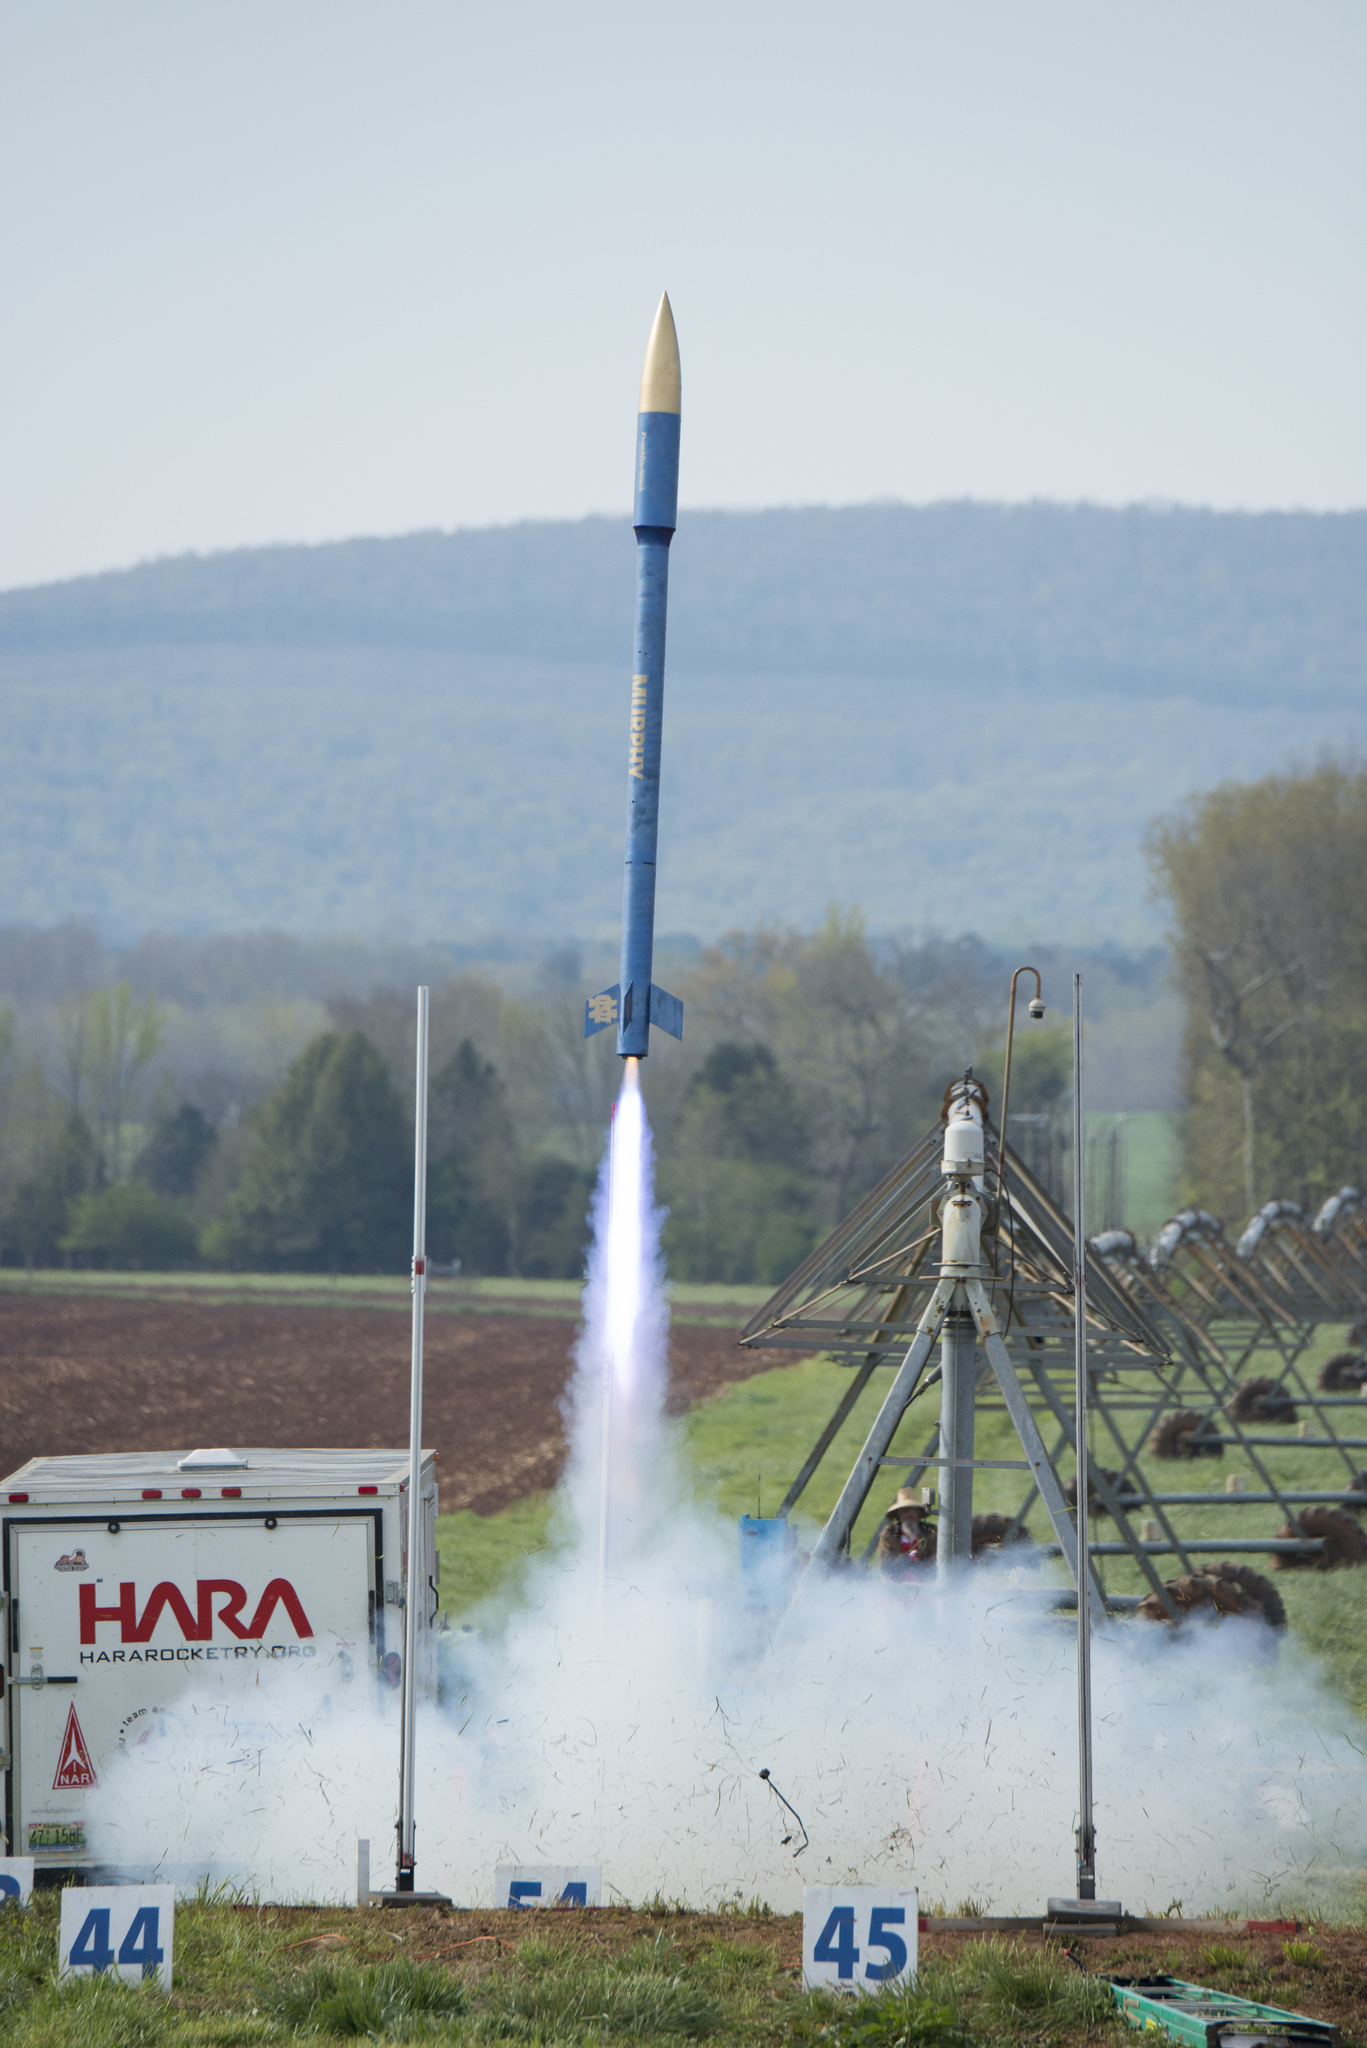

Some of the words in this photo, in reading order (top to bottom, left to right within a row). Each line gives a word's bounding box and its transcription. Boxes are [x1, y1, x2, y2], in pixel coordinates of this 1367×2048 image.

[628, 674, 648, 780] MURPHY
[79, 1577, 315, 1645] HARA
[80, 1645, 317, 1664] HARAROCKETRY.ORG
[122, 1707, 148, 1727] team
[60, 1773, 90, 1785] NAR
[69, 1906, 164, 1979] 44
[813, 1906, 908, 1981] 45
